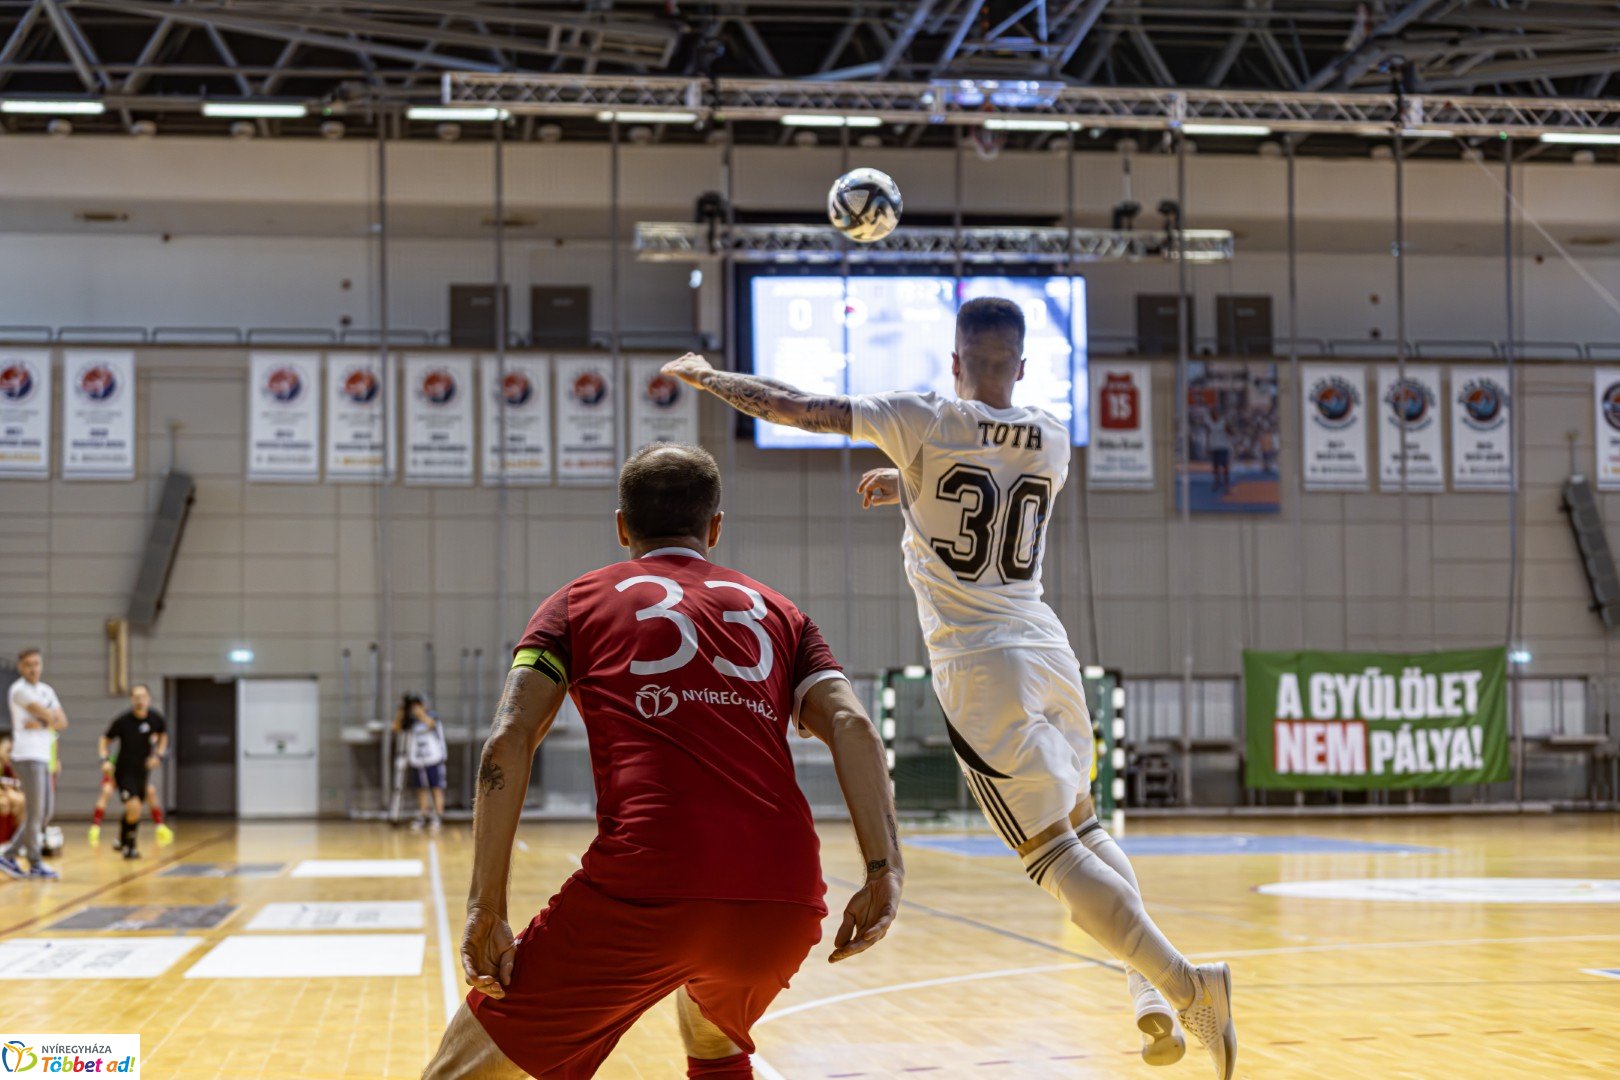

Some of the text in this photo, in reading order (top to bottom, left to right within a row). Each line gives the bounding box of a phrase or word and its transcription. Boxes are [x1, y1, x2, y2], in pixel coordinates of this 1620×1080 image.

[1107, 393, 1132, 419] 15
[979, 421, 1043, 451] TOTH
[931, 463, 1052, 584] 30
[615, 575, 774, 682] 33
[1277, 667, 1482, 720] A GYŰLÖLET
[1276, 723, 1484, 774] NEM PÁLYA!
